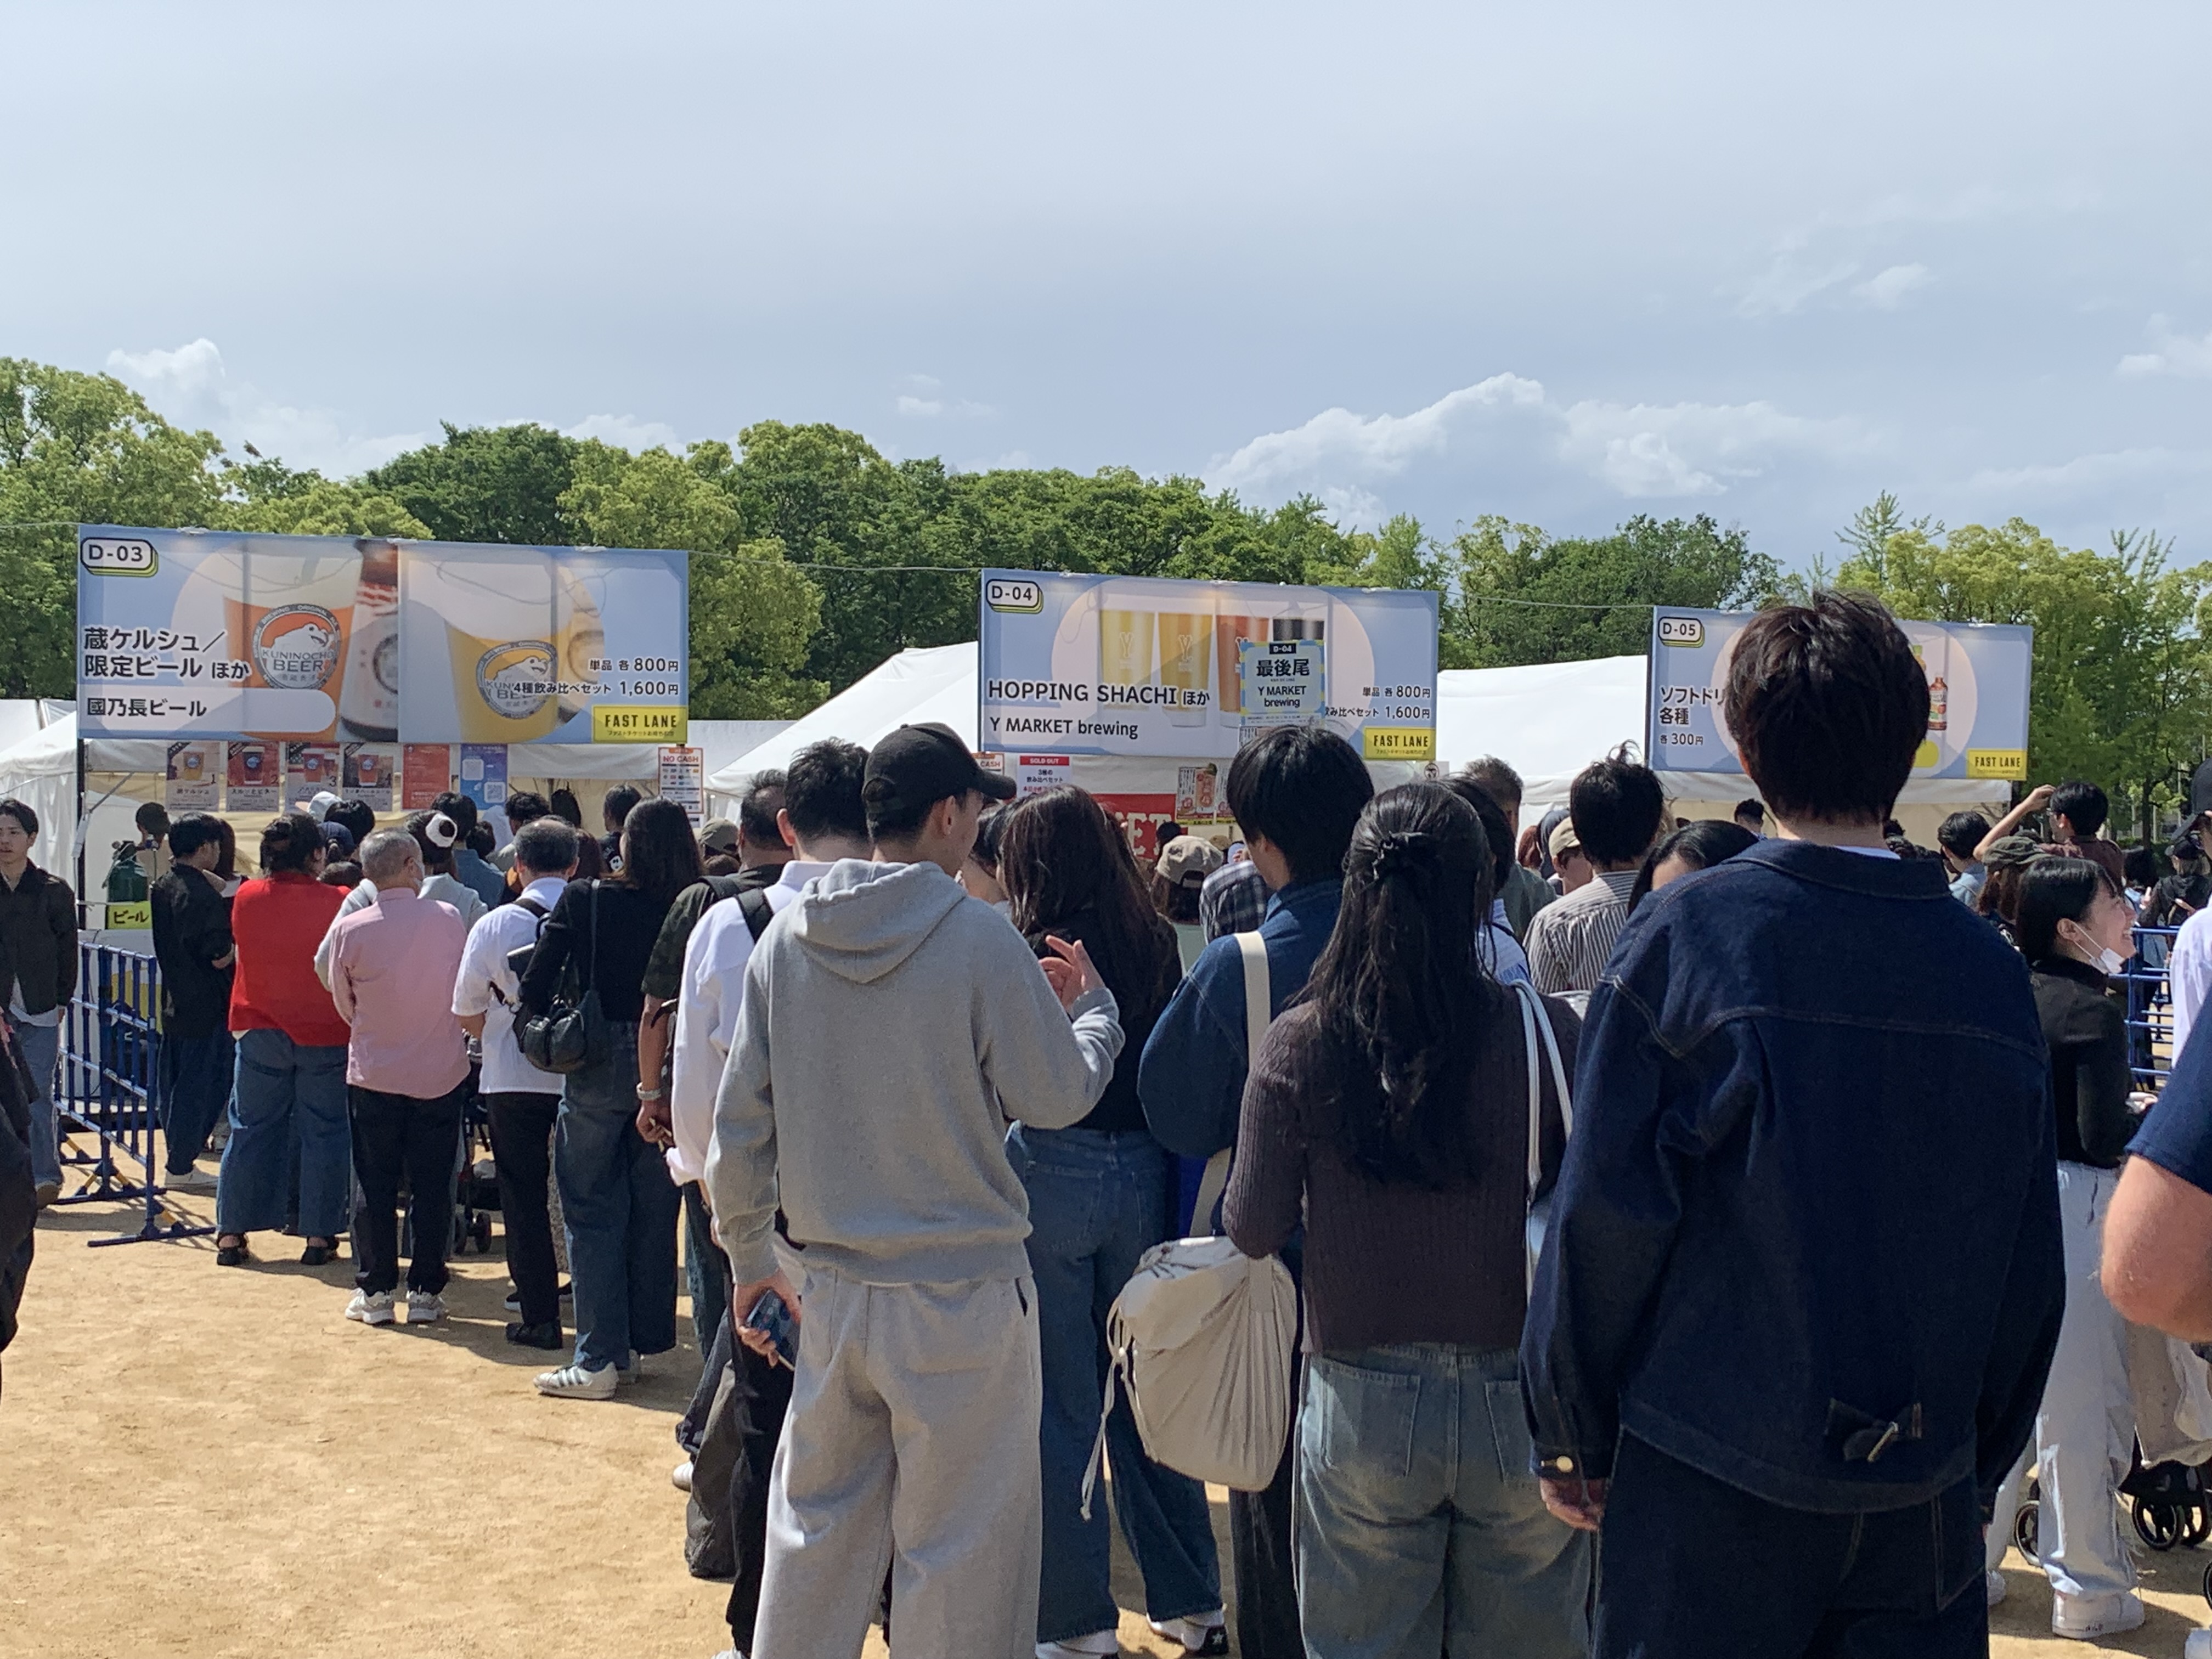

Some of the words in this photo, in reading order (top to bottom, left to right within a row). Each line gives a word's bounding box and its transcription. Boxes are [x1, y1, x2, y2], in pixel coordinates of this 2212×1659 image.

[89, 545, 143, 562] D-03
[992, 586, 1032, 601] D-04
[1663, 623, 1696, 636] D-05
[84, 655, 202, 678] 限定ビール
[212, 662, 249, 679] ほか
[274, 659, 324, 672] BEER
[1256, 659, 1310, 676] 最後尾
[514, 682, 612, 695] 4種飲み比べセット
[619, 681, 679, 696] 1,600円
[989, 681, 1088, 702] HOPPING
[1097, 685, 1177, 704] SHACHI
[1183, 691, 1210, 706] ほか
[1258, 686, 1265, 696] Y
[1267, 686, 1307, 696] MARKET
[1264, 698, 1300, 708] brewing
[1385, 706, 1430, 719] 1,600円
[1660, 707, 1689, 725] 各種
[605, 714, 639, 727] FAST
[645, 715, 676, 727] LANE
[990, 717, 1000, 731] Y
[1006, 718, 1073, 733] MARKET
[1079, 720, 1138, 740] brewing
[1374, 735, 1399, 747] FAST
[1403, 736, 1428, 747] LANE
[1671, 733, 1703, 746] 300円
[1975, 757, 1996, 768] FAST
[2000, 757, 2021, 768] LANE
[329, 776, 337, 787] 3
[114, 910, 149, 924] ビール
